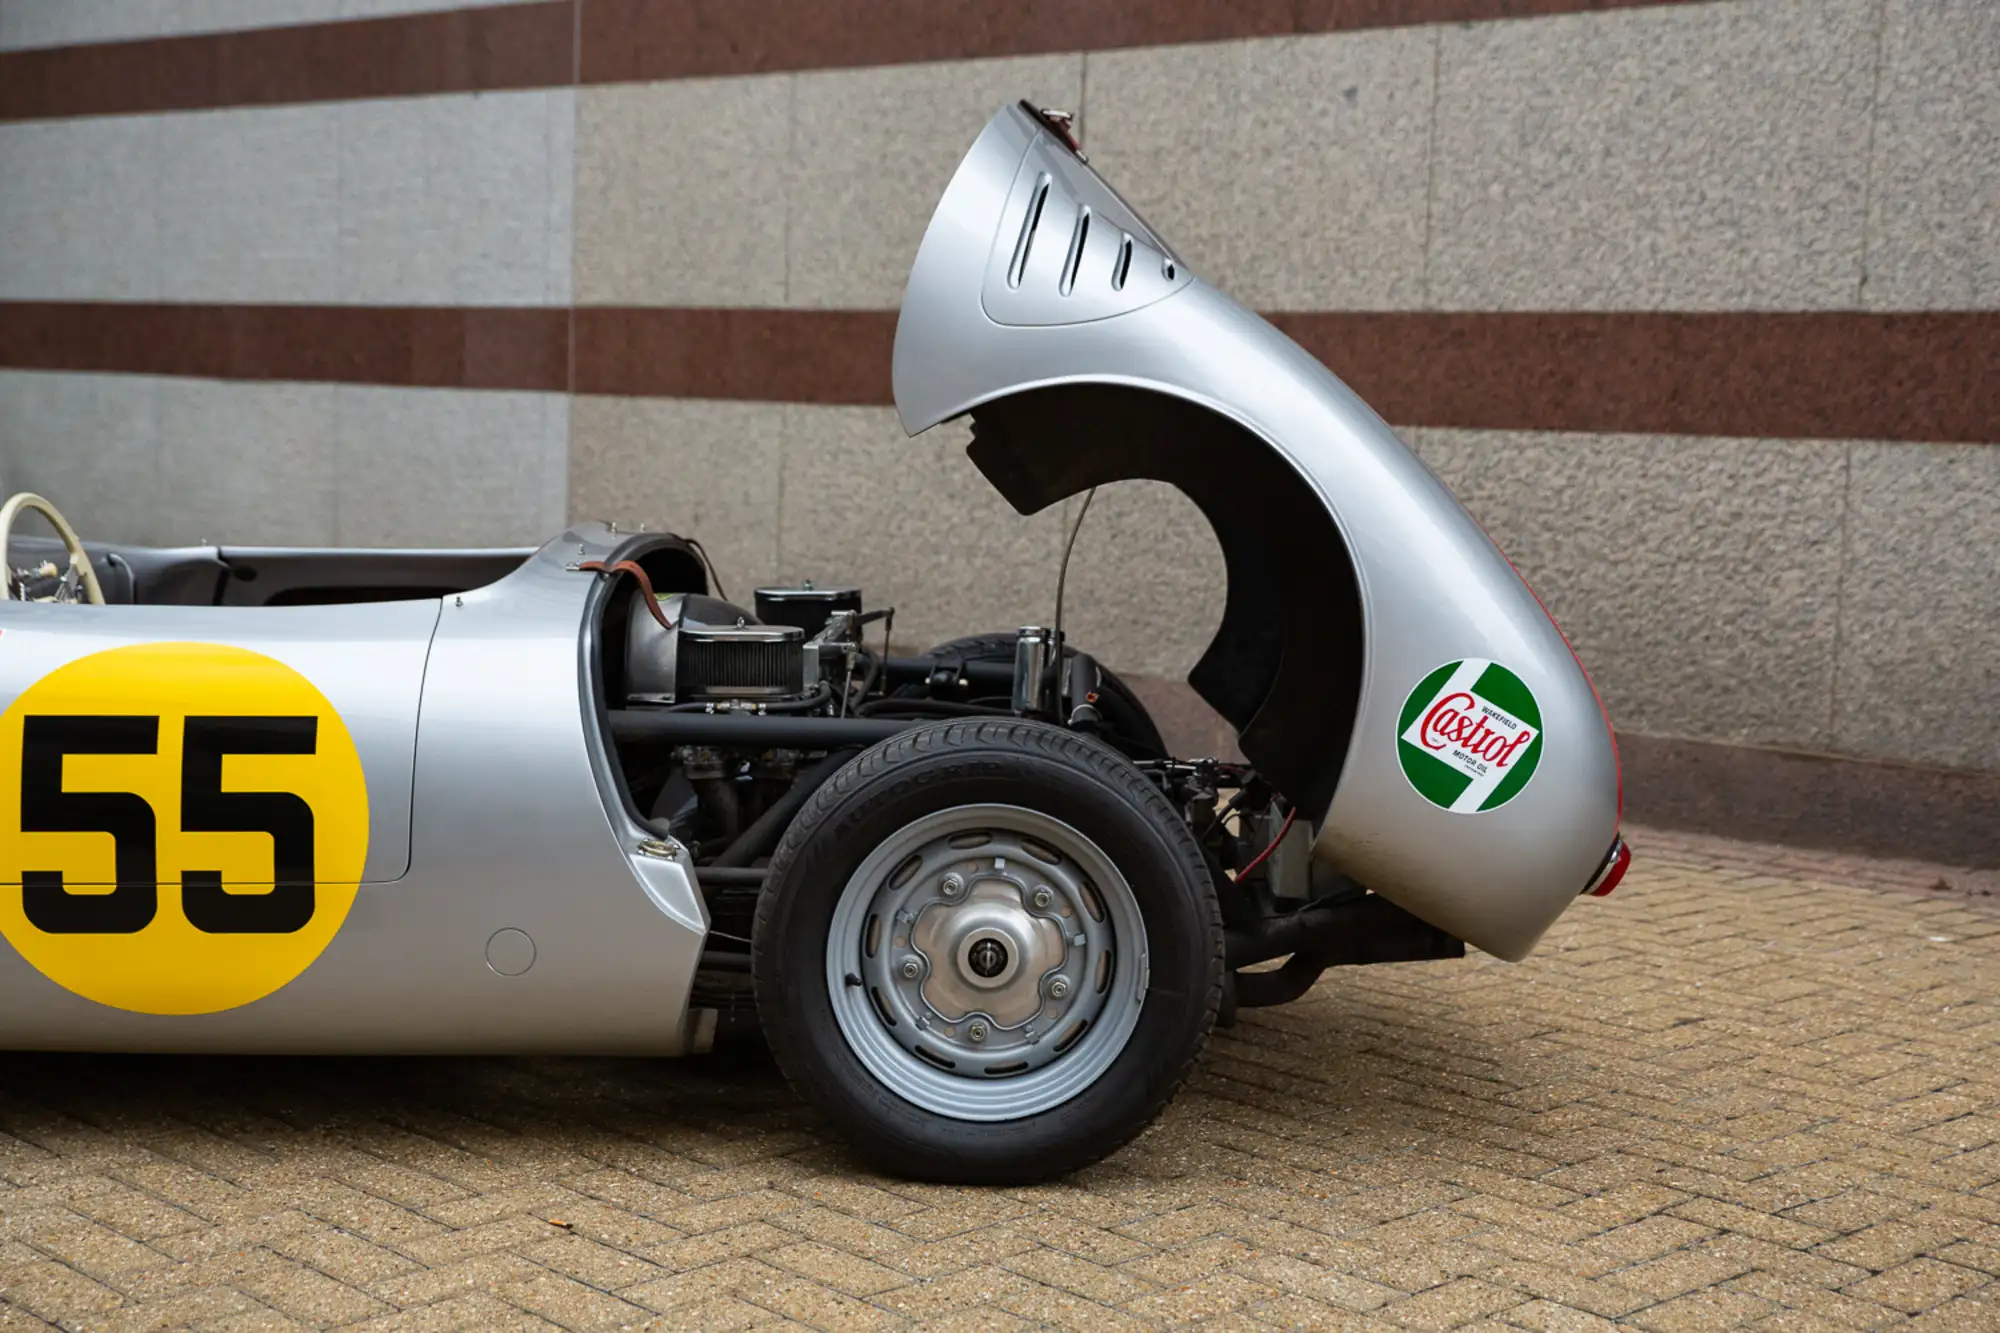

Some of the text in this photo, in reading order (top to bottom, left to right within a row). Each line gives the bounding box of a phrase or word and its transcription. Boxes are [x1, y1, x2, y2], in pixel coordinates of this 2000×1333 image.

[1420, 692, 1531, 768] Castrol
[1481, 706, 1517, 730] WAKEFIELD
[1452, 749, 1477, 766] MOTOR
[1477, 762, 1488, 774] OIL
[20, 715, 318, 934] 55
